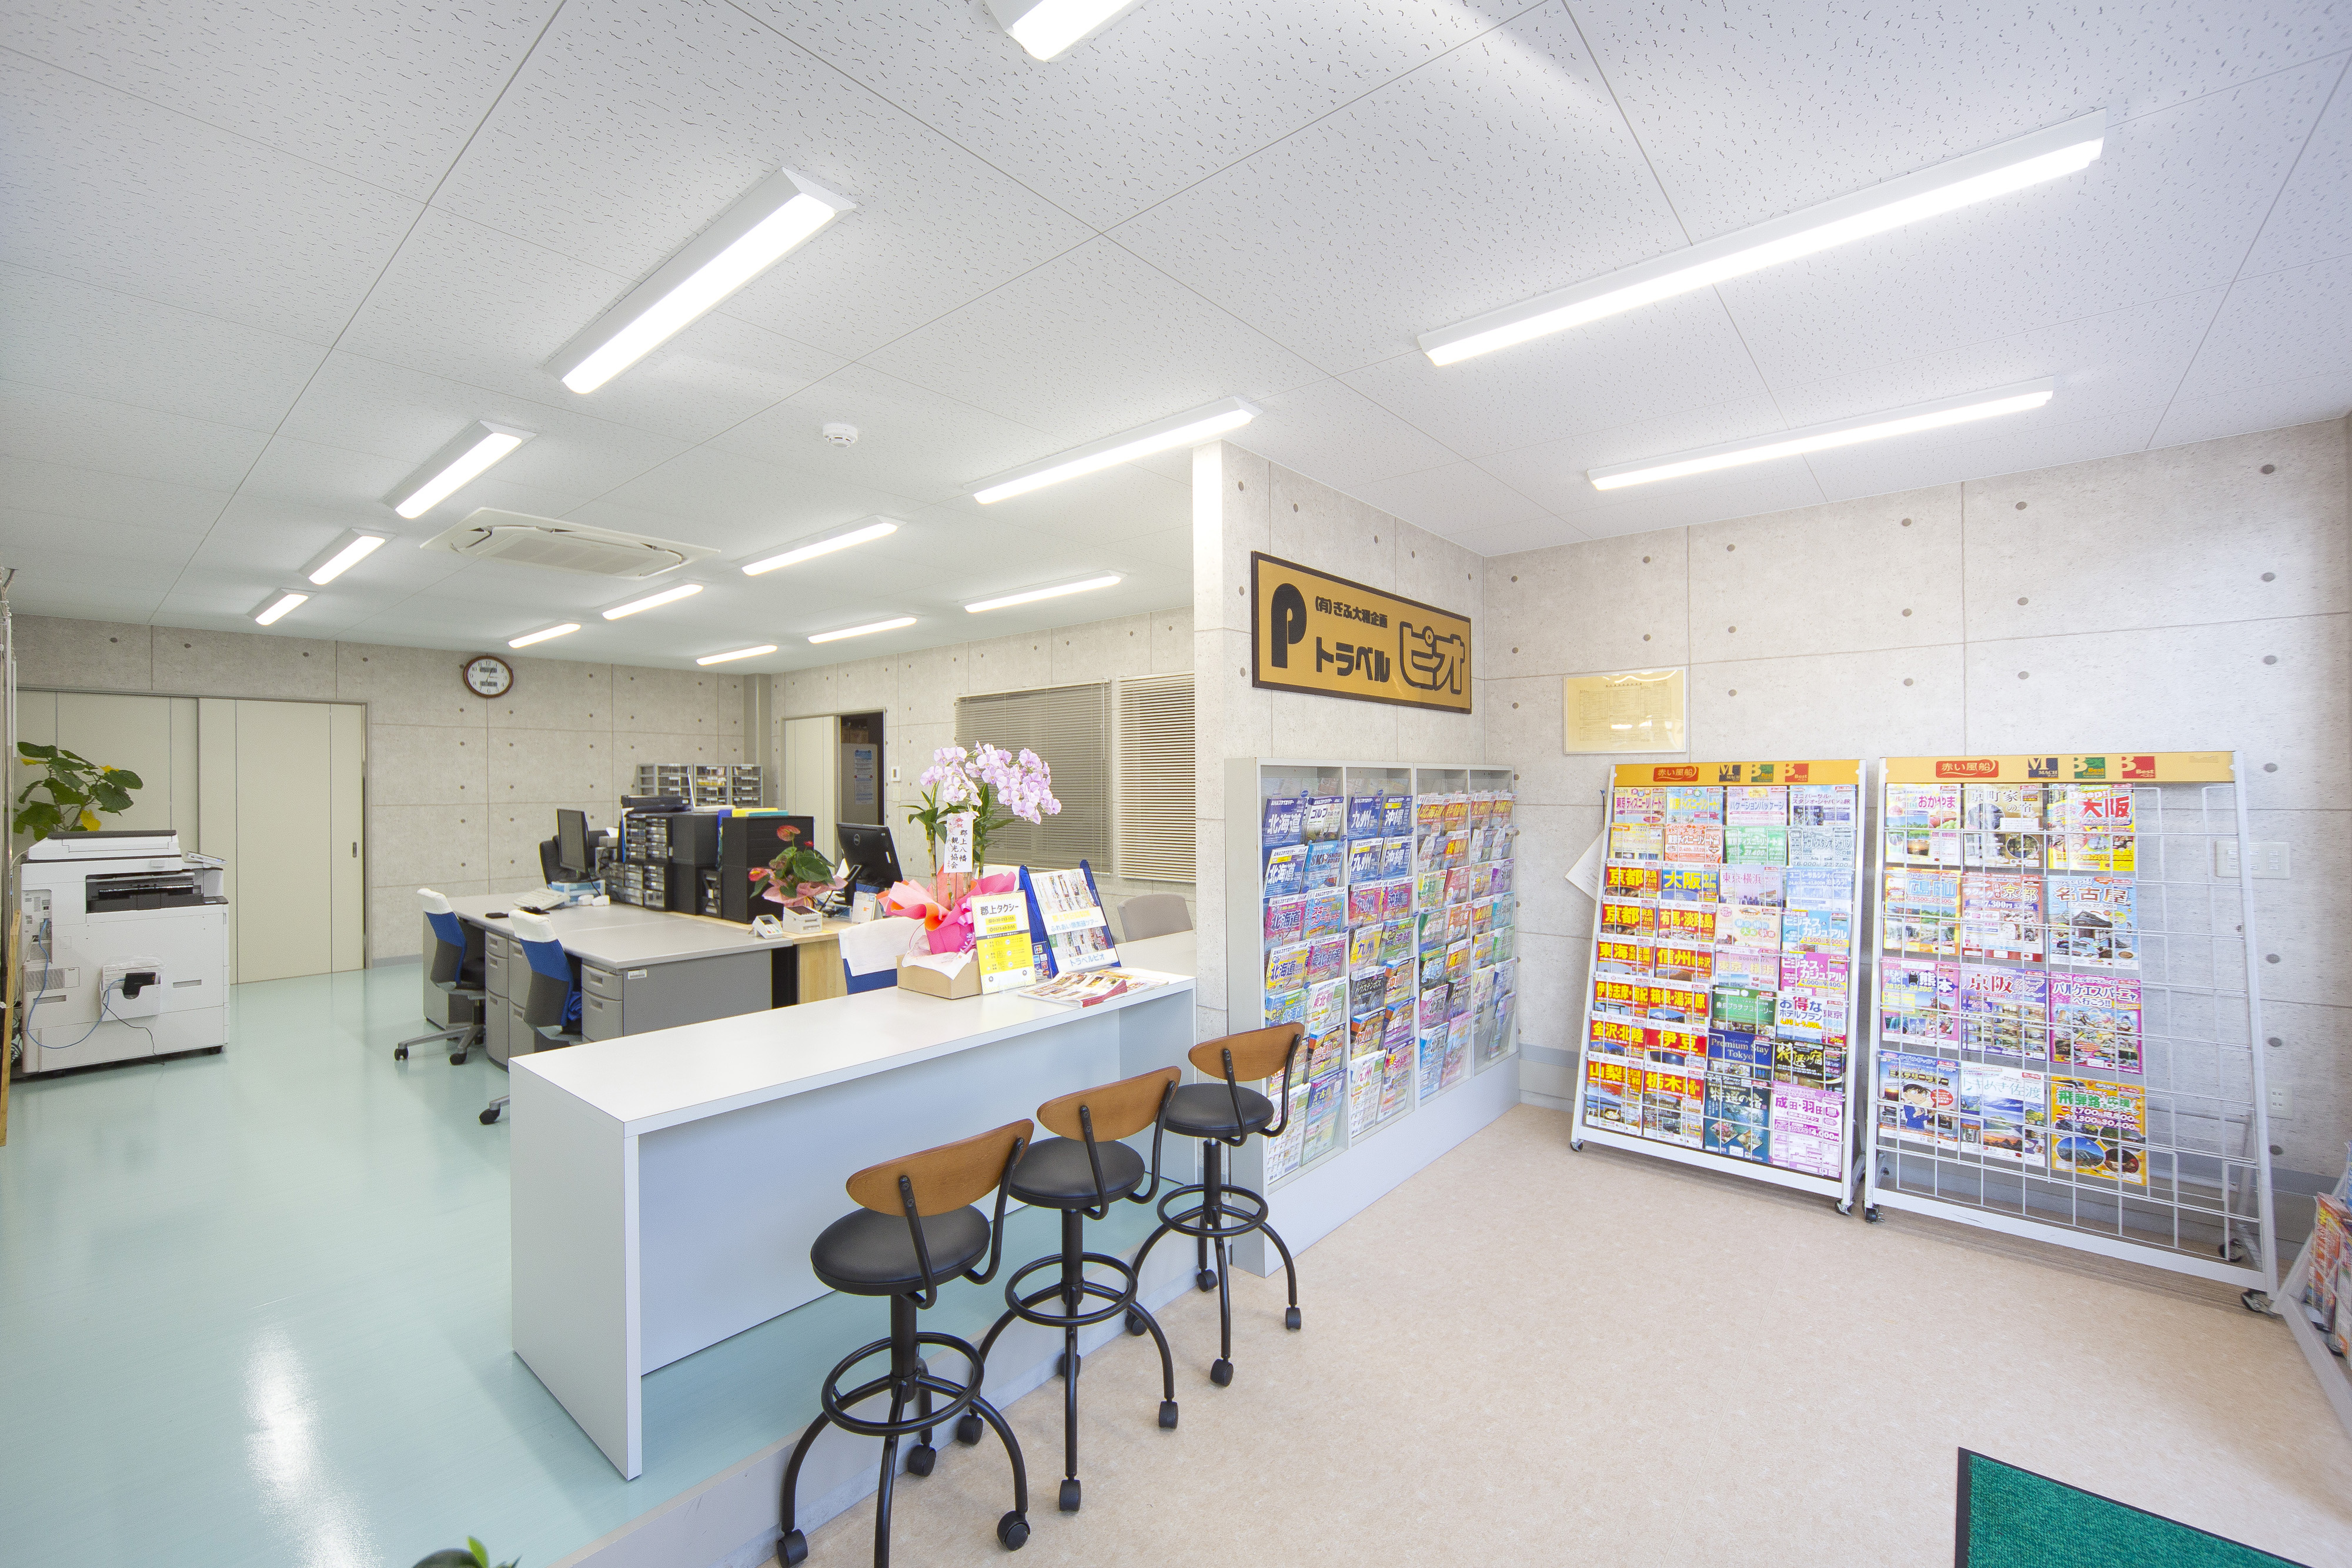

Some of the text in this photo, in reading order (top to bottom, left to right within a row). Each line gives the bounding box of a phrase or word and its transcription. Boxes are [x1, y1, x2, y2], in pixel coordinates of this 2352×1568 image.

[1315, 596, 1388, 628] (有)ぎふ大和企画
[1271, 583, 1307, 668] P
[1316, 621, 1465, 694] トラベル ピオ
[1658, 768, 1693, 777] 赤い風船
[1942, 763, 1991, 771] 赤い風船
[1918, 795, 1956, 808] おかやま
[1971, 790, 2019, 802] 京町家
[1311, 808, 1328, 819] ゴルフ
[2007, 802, 2033, 813] の宿
[2077, 795, 2130, 818] 大阪
[1267, 813, 1301, 834] 北海道
[1351, 810, 1372, 828] 九州
[1384, 809, 1404, 826] 沖縄
[951, 837, 959, 869] 観光協会
[959, 830, 967, 862] 郡上八幡
[1352, 853, 1372, 872] 九州
[1385, 850, 1405, 867] 沖縄
[1268, 862, 1296, 884] 北海道
[1608, 868, 1644, 886] 京都
[1664, 872, 1701, 890] 大阪
[1722, 872, 1762, 884] 東京・横浜
[1907, 880, 1957, 898] 広島・岡山
[2002, 883, 2039, 903] 京都
[2054, 887, 2129, 905] 名古屋
[1356, 895, 1375, 913] 九州
[1387, 891, 1404, 908] 沖縄
[980, 904, 1019, 915] 郡上タクシー
[1605, 905, 1640, 924] 京都
[1642, 908, 1653, 917] 奈良
[1271, 910, 1301, 932] 北海道
[1311, 911, 1341, 927] スノーボード
[1661, 910, 1714, 928] 有馬・淡路島
[1785, 917, 1821, 927] ビジネス
[1803, 927, 1847, 940] カジュアル
[1357, 940, 1375, 957] 九州
[1599, 942, 1628, 959] 東海
[1629, 945, 1650, 954] 名古屋
[1658, 949, 1690, 965] 信州
[1691, 955, 1711, 968] 軽井沢
[1718, 961, 1742, 971] 東京
[1750, 962, 1775, 975] 横浜
[1782, 958, 1819, 971] ビジネス
[1270, 960, 1297, 982] 北海道
[1800, 970, 1846, 982] カジュアル
[1919, 971, 1953, 992] 熊本
[1969, 974, 2014, 994] 京阪
[1596, 982, 1648, 1002] 伊勢志摩・南紀
[1651, 989, 1706, 1009] 箱根・湯河原
[2053, 982, 2137, 1001] パルケエスパーニャ
[1780, 996, 1822, 1012] お得な
[2073, 998, 2111, 1007] へ行こう!!
[1282, 1004, 1305, 1024] 北海道
[1779, 1009, 1823, 1021] ホテルプラン
[1593, 1022, 1643, 1043] 金沢・北陸
[1658, 1031, 1698, 1051] 伊豆
[1712, 1038, 1769, 1055] Premium Stay
[1727, 1049, 1753, 1061] Tokyo
[1776, 1042, 1823, 1068] 特選の宿
[1589, 1063, 1622, 1081] 山梨
[1889, 1069, 1949, 1086] ミステリーツアー
[1646, 1072, 1682, 1092] 栃木
[1963, 1078, 2041, 1099] トキめき佐渡
[1709, 1086, 1763, 1109] 特選の宿
[1775, 1096, 1823, 1115] 成田・羽田
